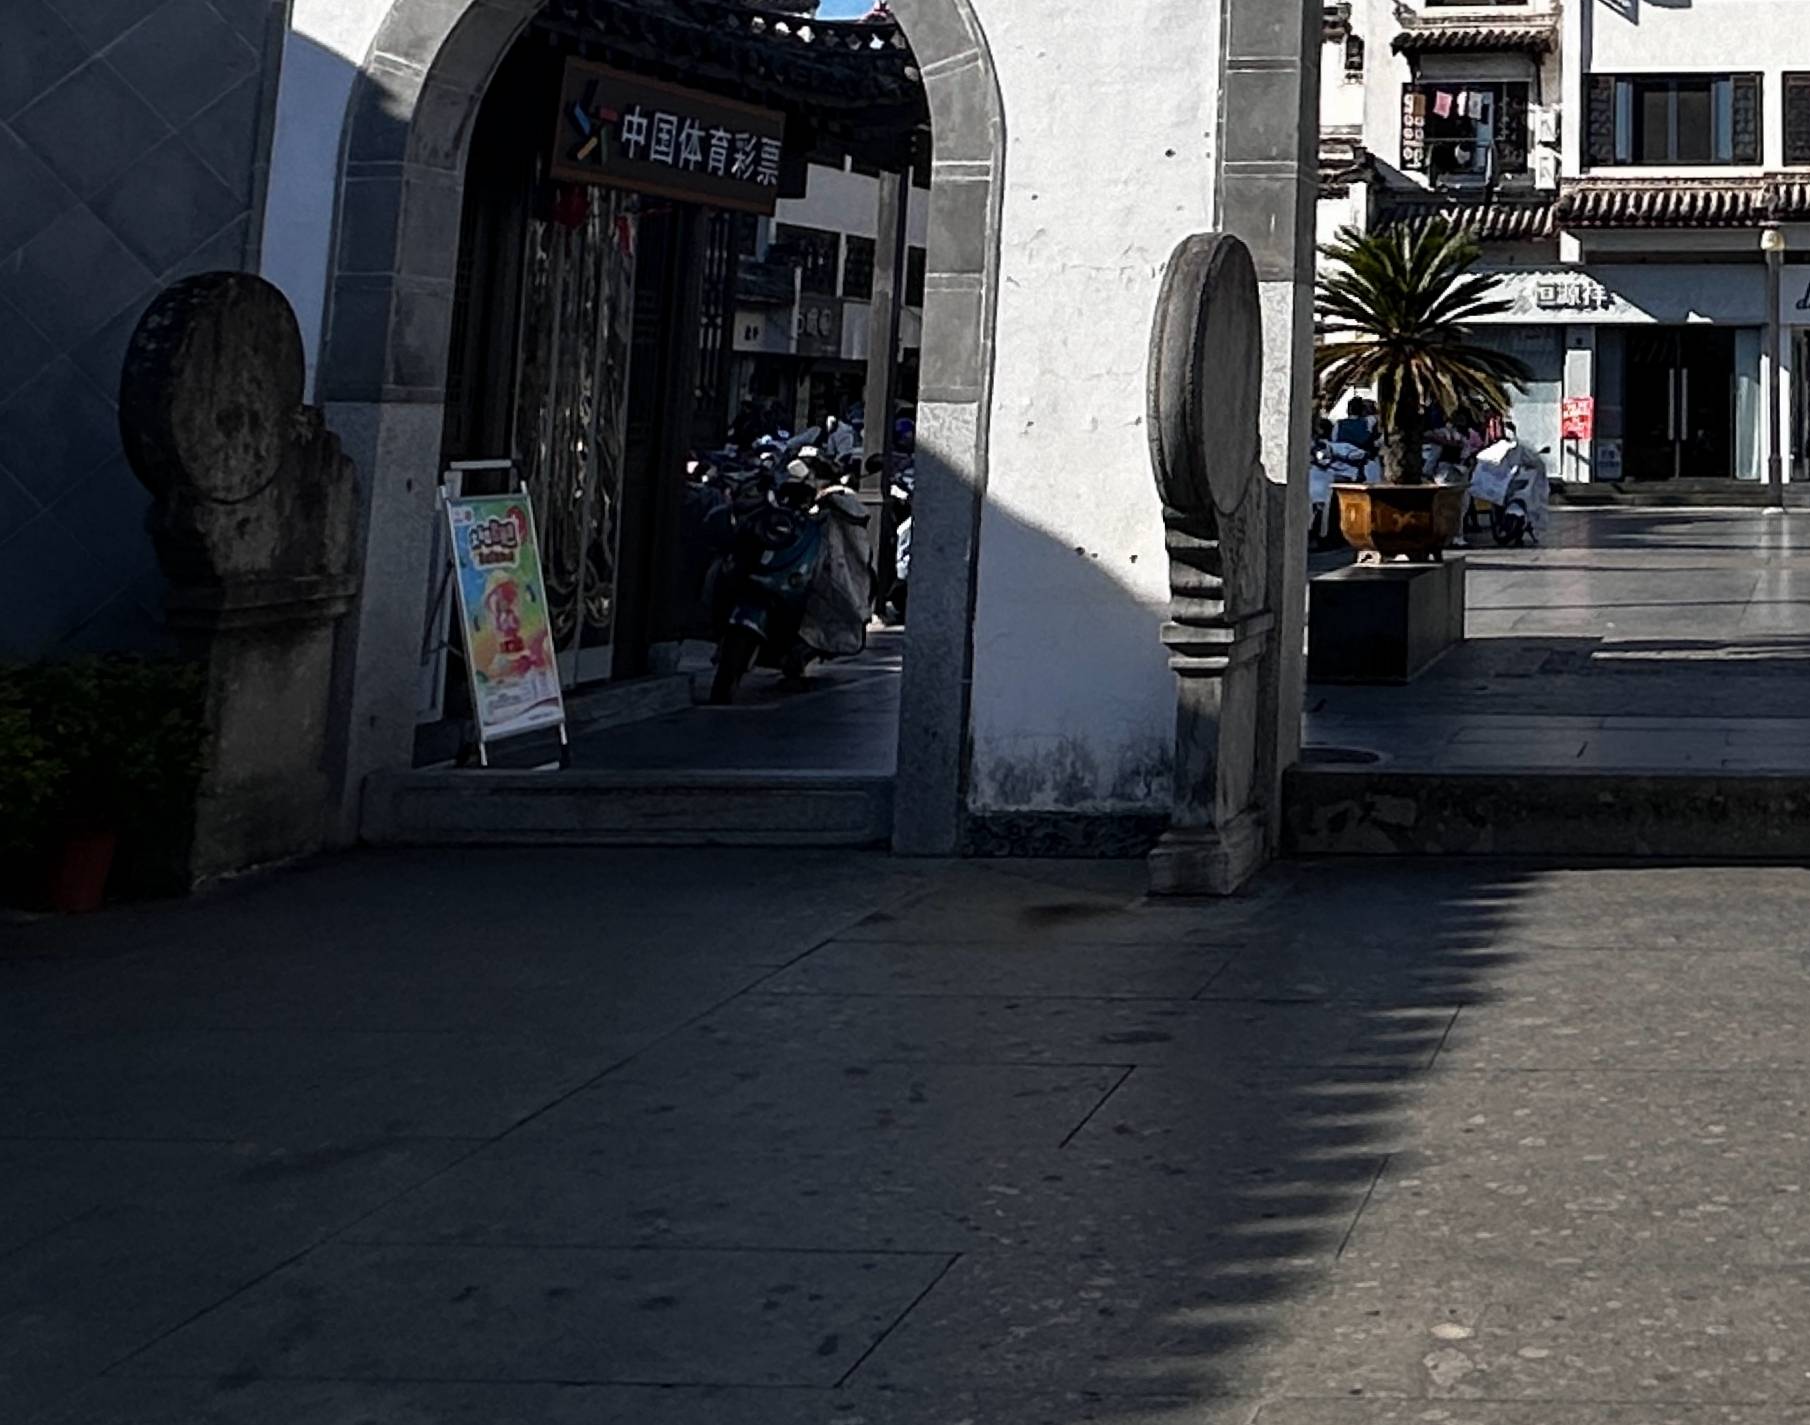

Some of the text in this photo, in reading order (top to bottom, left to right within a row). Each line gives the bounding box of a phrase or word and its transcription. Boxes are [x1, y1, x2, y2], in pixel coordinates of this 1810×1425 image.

[621, 105, 782, 186] 中国体育彩票
